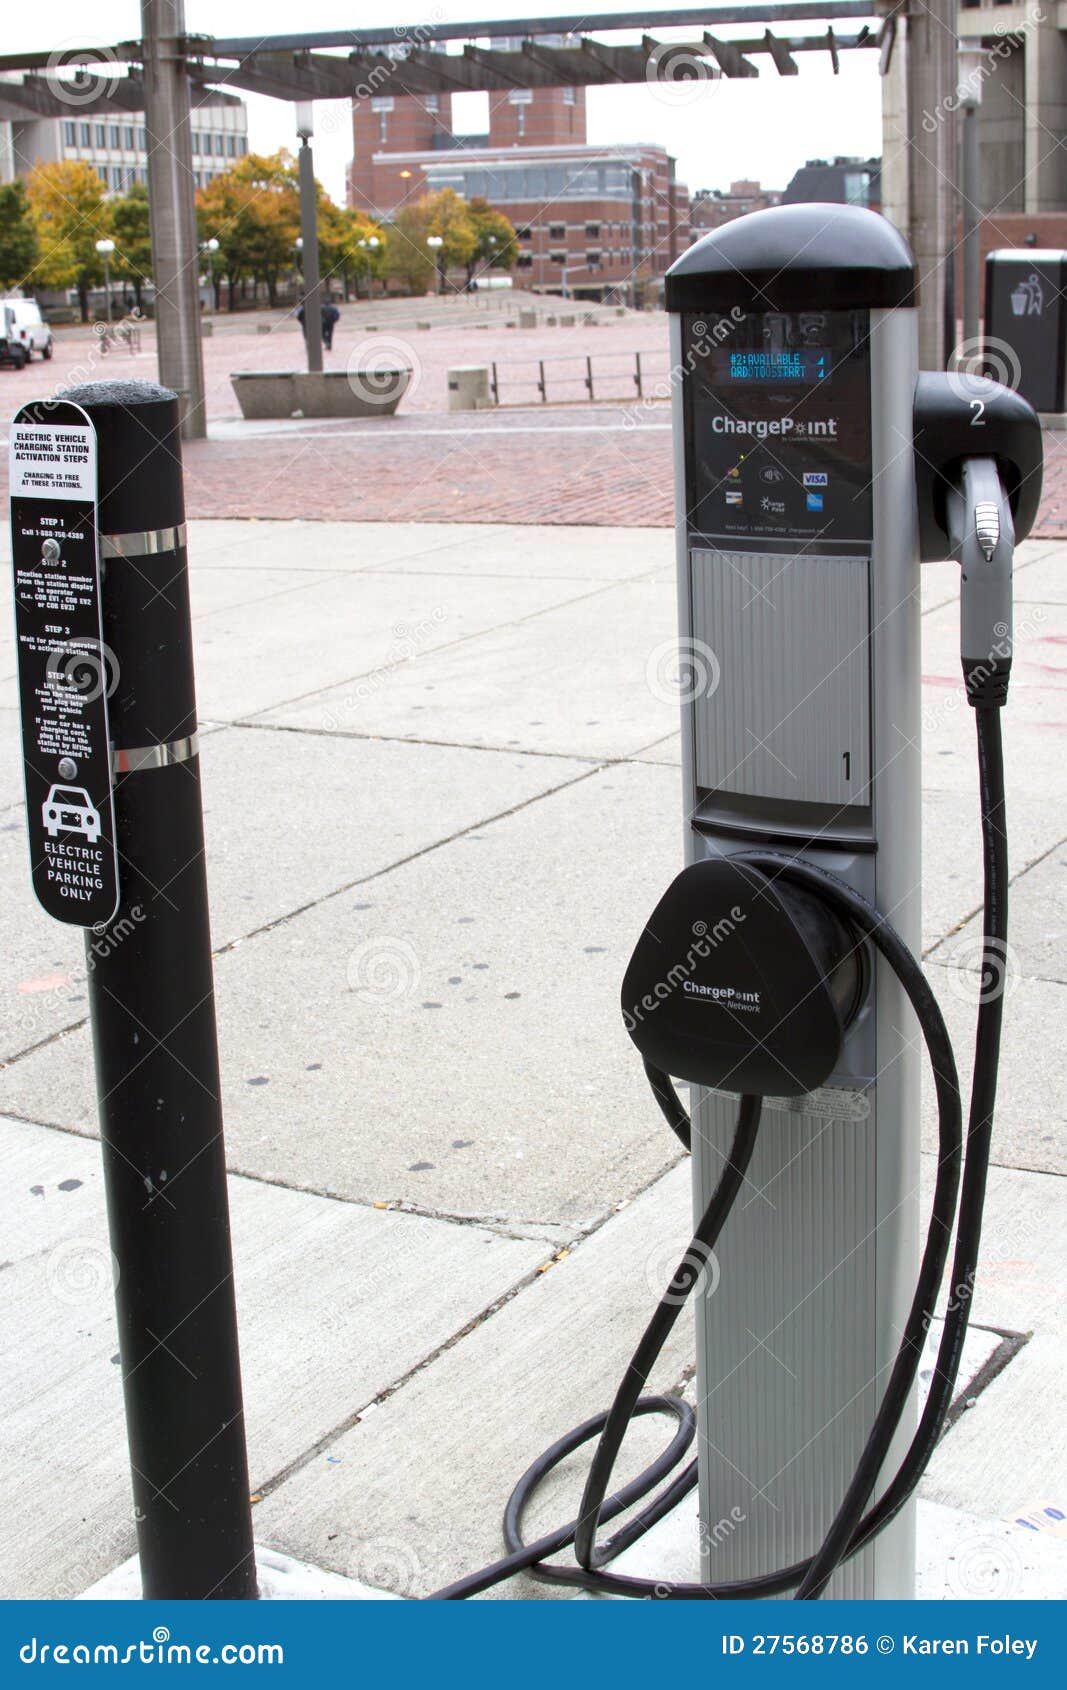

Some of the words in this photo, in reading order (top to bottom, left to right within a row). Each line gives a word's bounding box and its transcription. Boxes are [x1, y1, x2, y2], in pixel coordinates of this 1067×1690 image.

[969, 400, 986, 426] 2
[712, 416, 838, 438] ChargePoint
[16, 432, 52, 442] ELECTRIC
[54, 434, 86, 443] VEHICLE
[14, 442, 54, 452] CHARGING
[56, 444, 90, 454] STATION
[16, 452, 60, 462] ACTIVATION
[64, 454, 88, 464] STEPS
[24, 472, 54, 480] CHARGING
[805, 474, 826, 484] VISA
[40, 518, 58, 526] STEP
[60, 518, 64, 527] 1
[22, 528, 34, 536] Call
[42, 558, 60, 566] STEP
[62, 560, 67, 568] 2
[17, 570, 42, 579] Mention
[44, 572, 67, 581] station
[68, 574, 93, 583] number
[16, 578, 33, 586] from
[46, 580, 69, 589] station
[70, 582, 94, 592] display
[46, 588, 74, 597] operator
[44, 625, 62, 634] STEP
[65, 626, 70, 635] 3
[20, 635, 34, 644] Wait
[36, 636, 46, 644] for
[48, 638, 68, 647] phone
[69, 640, 98, 650] operator
[38, 645, 64, 654] activate
[48, 672, 66, 680] STEP
[44, 682, 55, 690] Lift
[35, 688, 50, 697] from
[52, 690, 63, 698] the
[64, 692, 88, 701] station
[42, 704, 57, 712] your
[58, 706, 82, 715] vehicle
[40, 725, 68, 736] charging
[44, 719, 58, 727] your
[60, 720, 70, 728] car
[72, 721, 84, 730] has
[40, 732, 54, 741] plug
[62, 735, 76, 743] into
[78, 736, 88, 744] the
[37, 740, 60, 748] station
[62, 741, 70, 750] by
[72, 742, 92, 753] lifting
[40, 746, 57, 754] latch
[842, 752, 850, 781] 1
[44, 842, 103, 861] ELECTRIC
[48, 856, 100, 875] VEHICLE
[47, 870, 103, 889] PARKING
[60, 886, 92, 901] ONLY
[683, 981, 760, 1003] ChargePoint
[727, 1000, 760, 1014] Network
